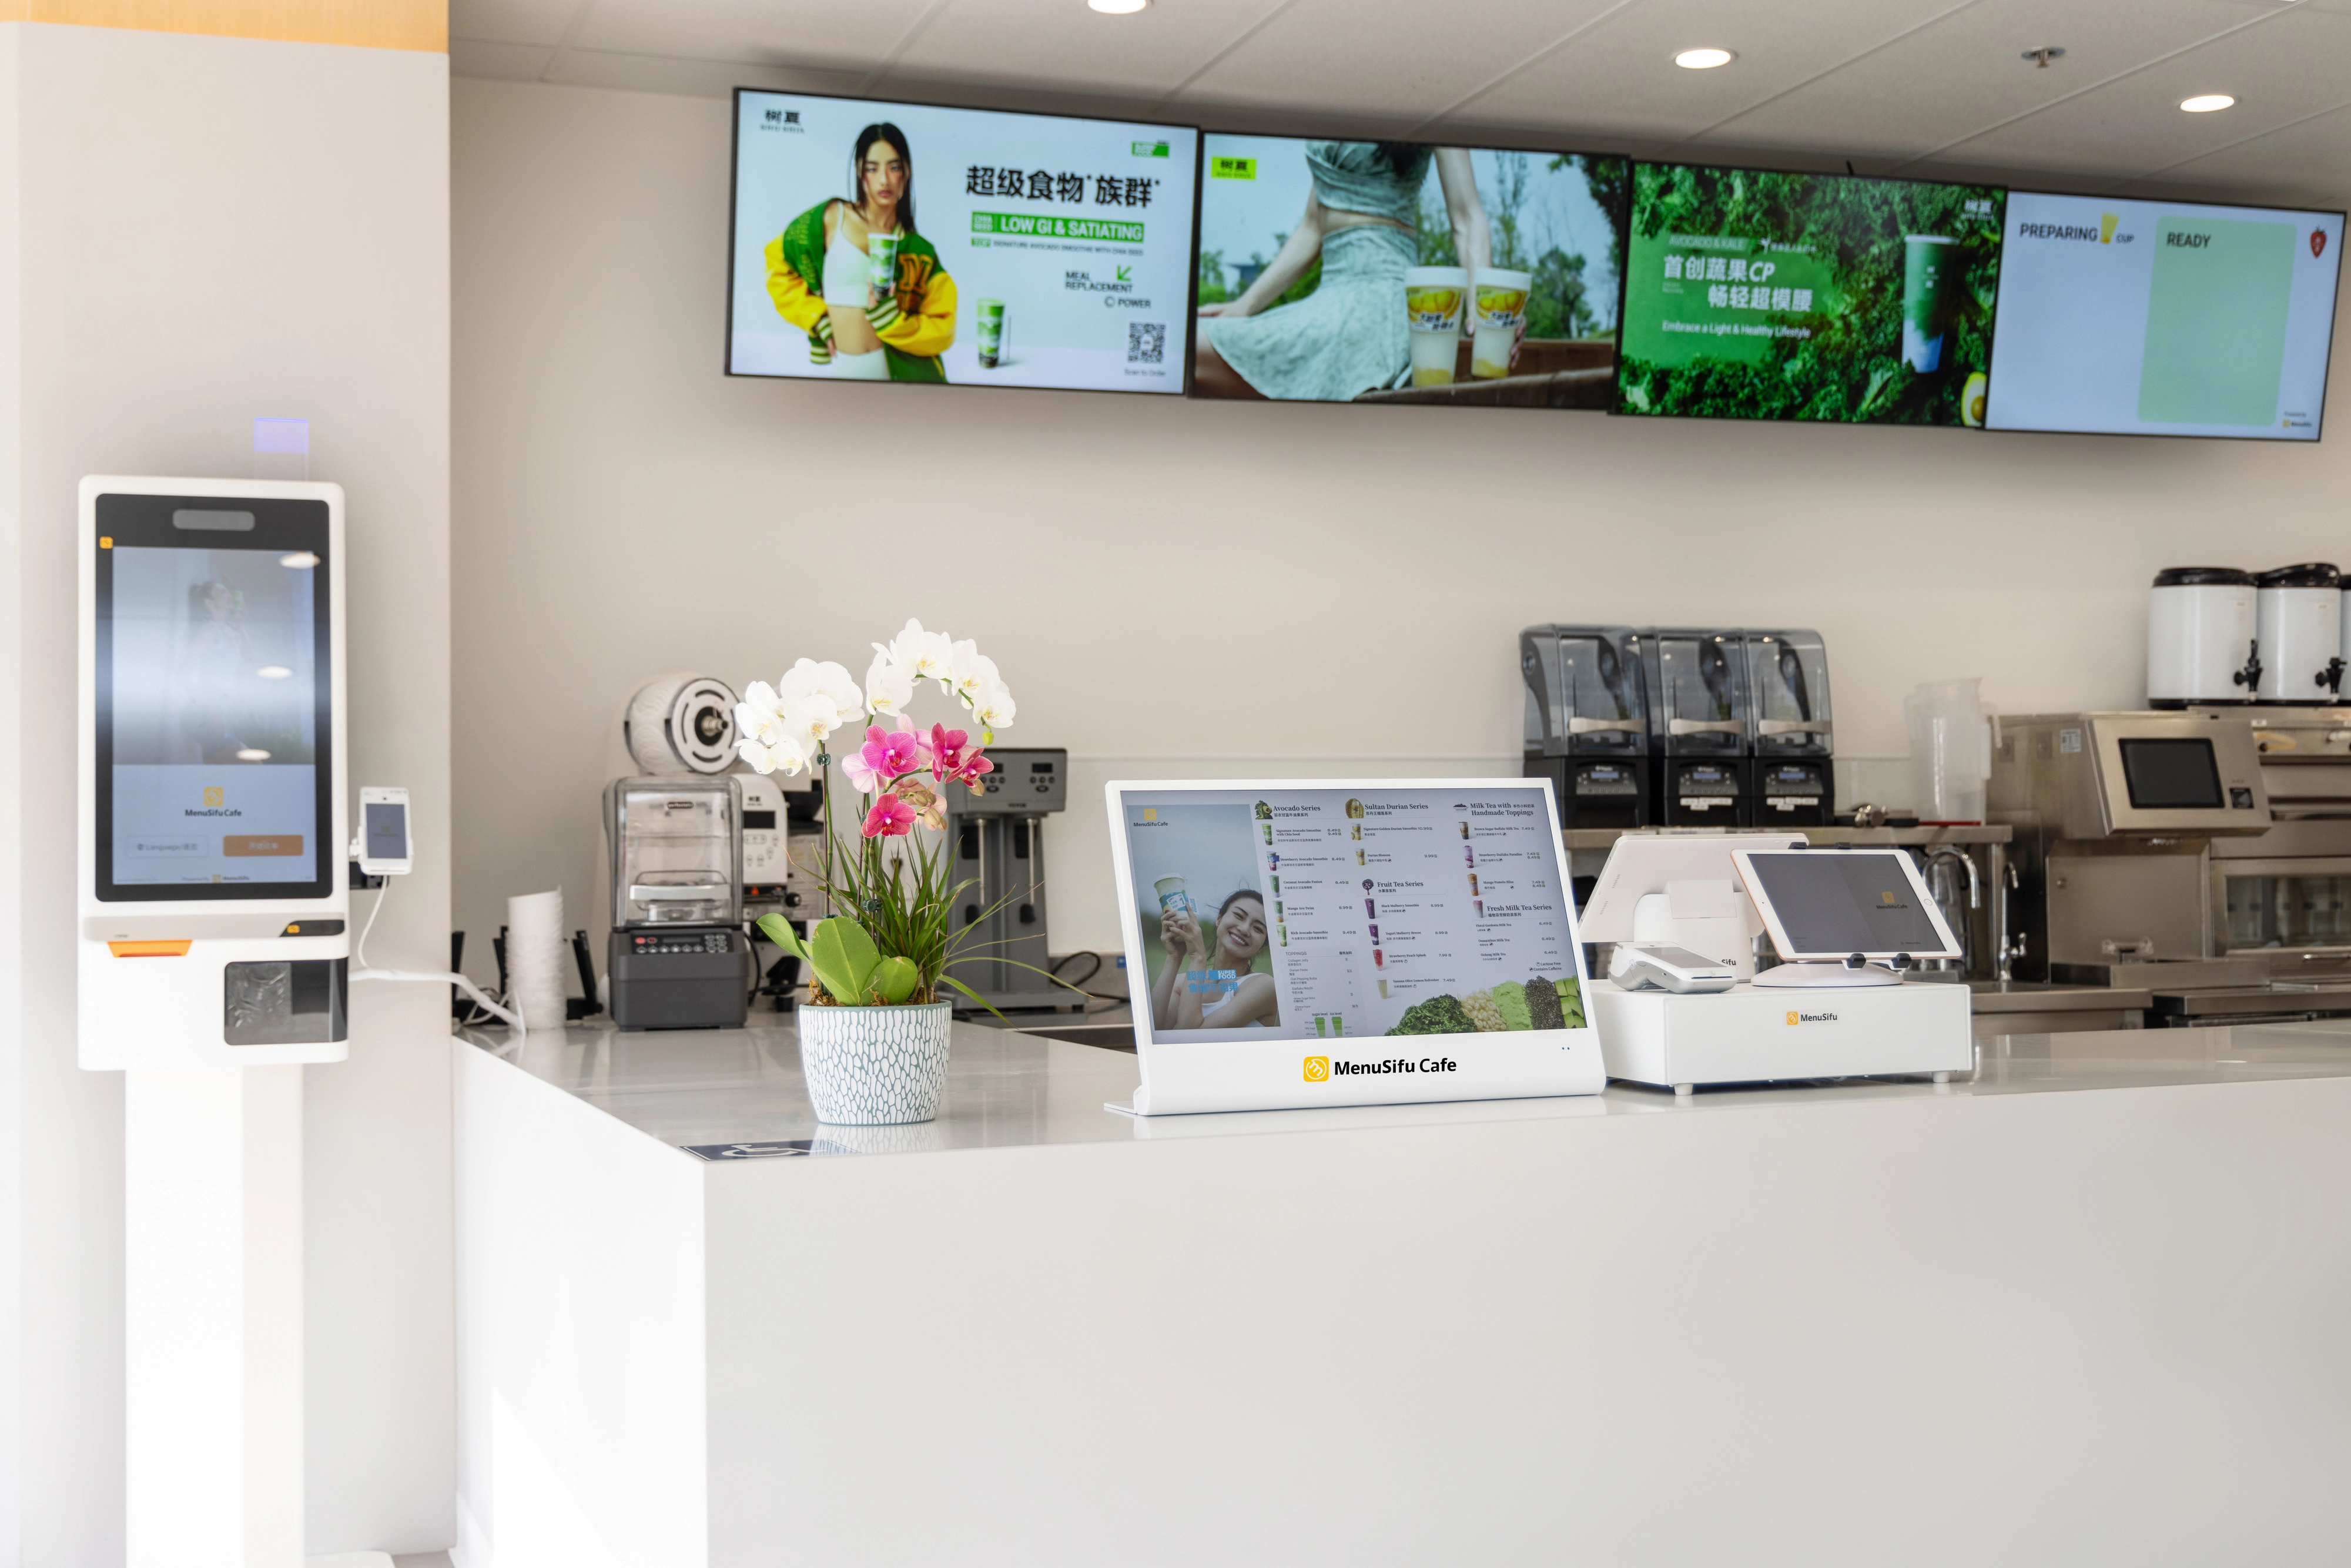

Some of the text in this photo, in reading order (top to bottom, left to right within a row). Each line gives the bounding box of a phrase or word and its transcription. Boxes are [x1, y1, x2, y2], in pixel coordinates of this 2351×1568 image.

[1001, 216, 1143, 241] LOW GI & SATIATING
[2020, 223, 2098, 242] PREPARING
[1669, 236, 1744, 250] AVOCADO & KALE
[2166, 231, 2211, 248] READY
[1066, 271, 1090, 281] MEAL
[1664, 254, 1776, 283] 首创蔬果CP
[1066, 282, 1133, 293] REPLACEMENT
[1118, 298, 1151, 309] POWER
[1662, 320, 1811, 340] Embrace a Light & Healthy Lifestyle
[185, 809, 242, 817] MenuSifu Cafe
[1800, 1013, 1837, 1022] MenuSifu
[1335, 1057, 1457, 1076] MenuSifu Cafe
